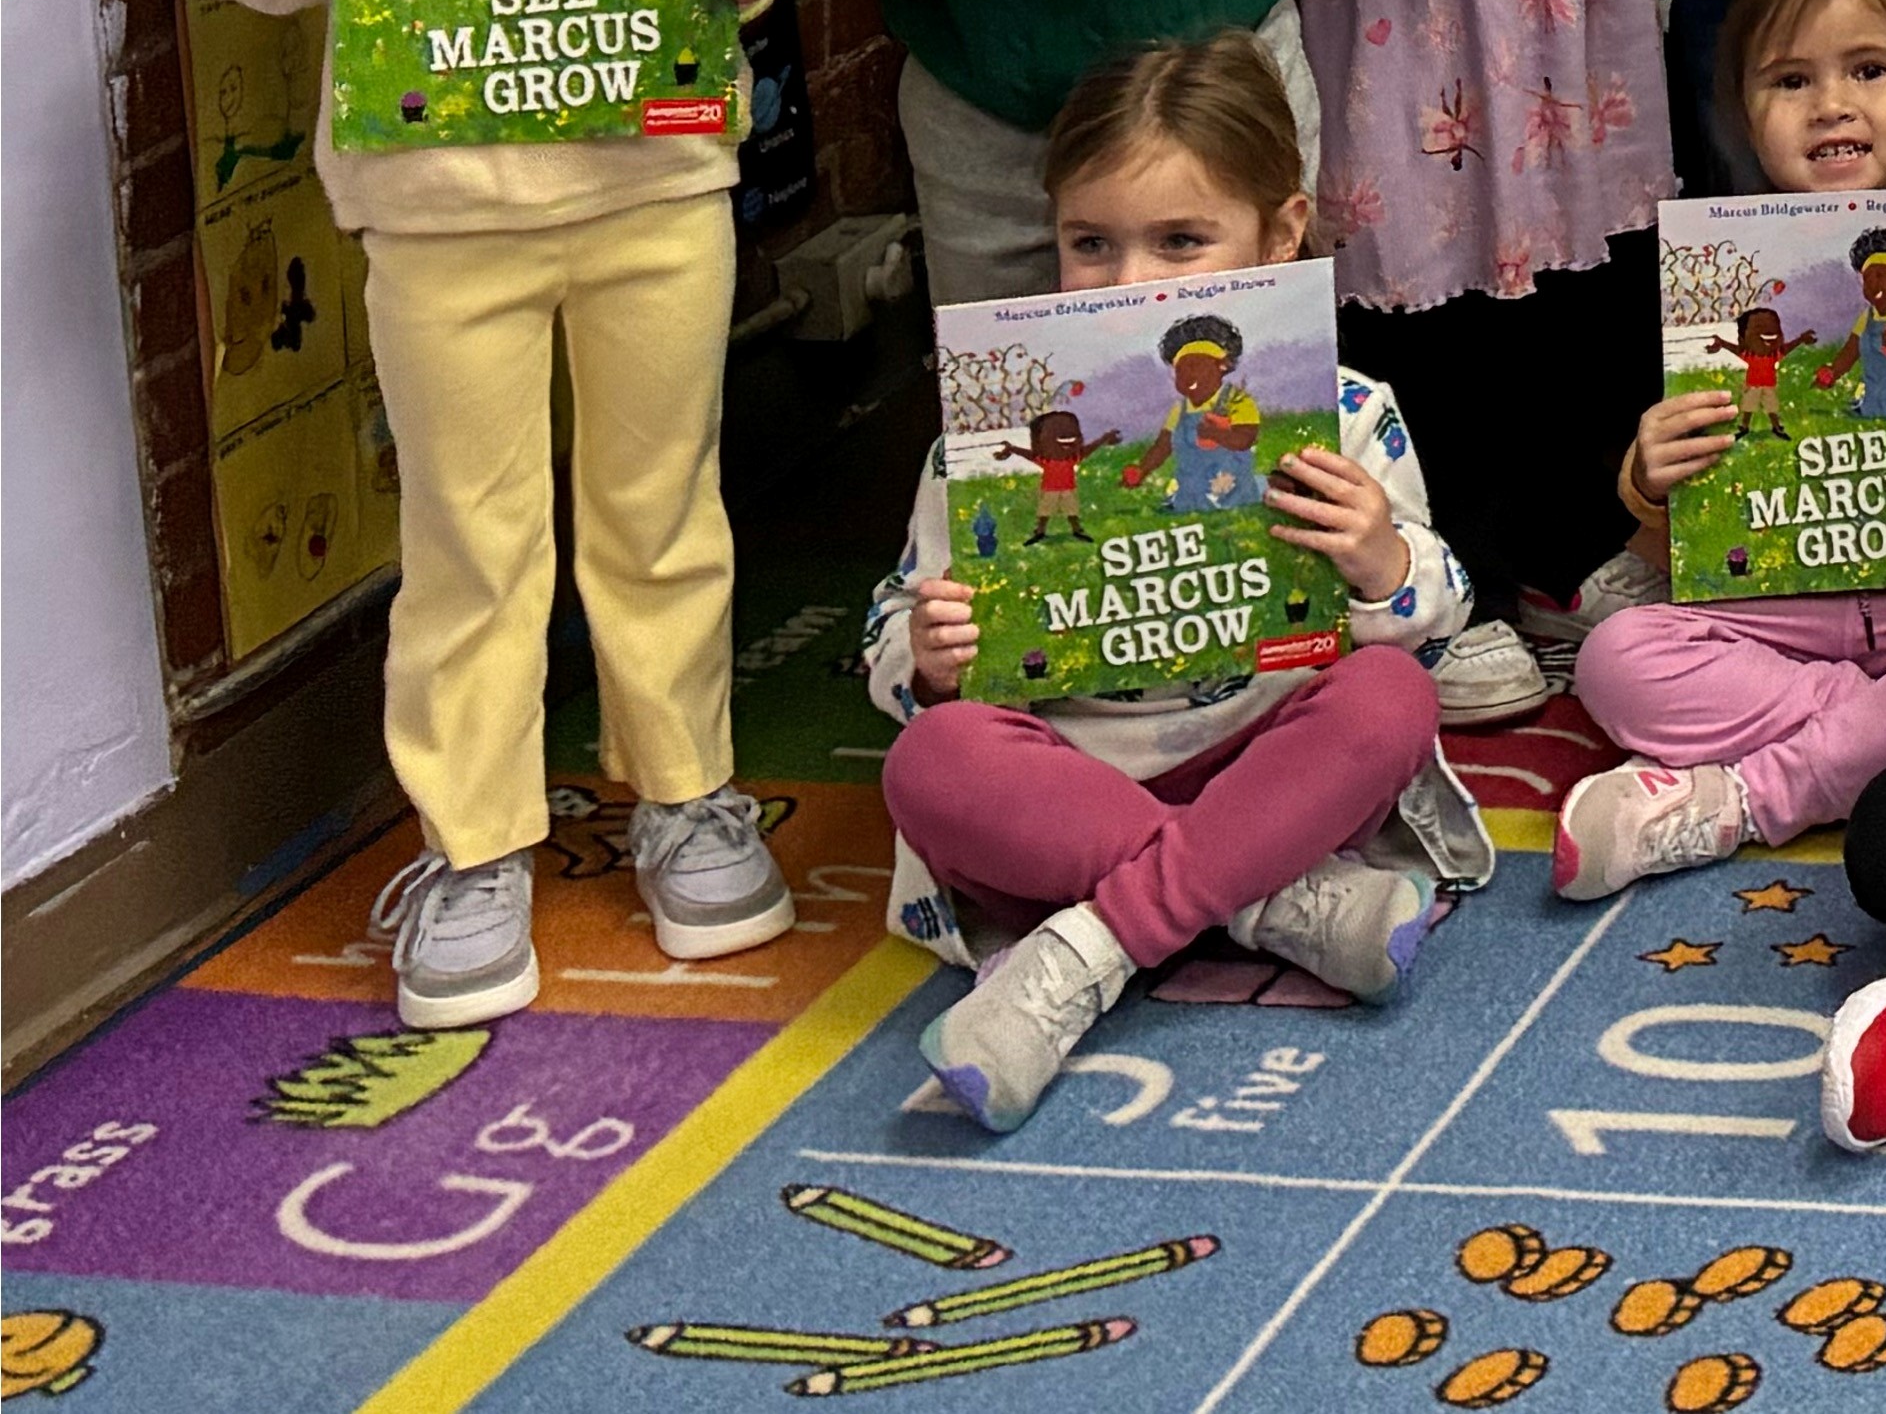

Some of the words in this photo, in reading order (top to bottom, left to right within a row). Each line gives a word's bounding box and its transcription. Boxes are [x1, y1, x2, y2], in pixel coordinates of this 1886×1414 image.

[428, 10, 660, 71] MARCUS
[484, 60, 641, 113] GROW
[1101, 524, 1206, 577] SEE
[1045, 558, 1270, 633] MARCUS
[1102, 605, 1252, 665] GROW
[1170, 1043, 1326, 1137] five
[1547, 1003, 1837, 1157] 10
